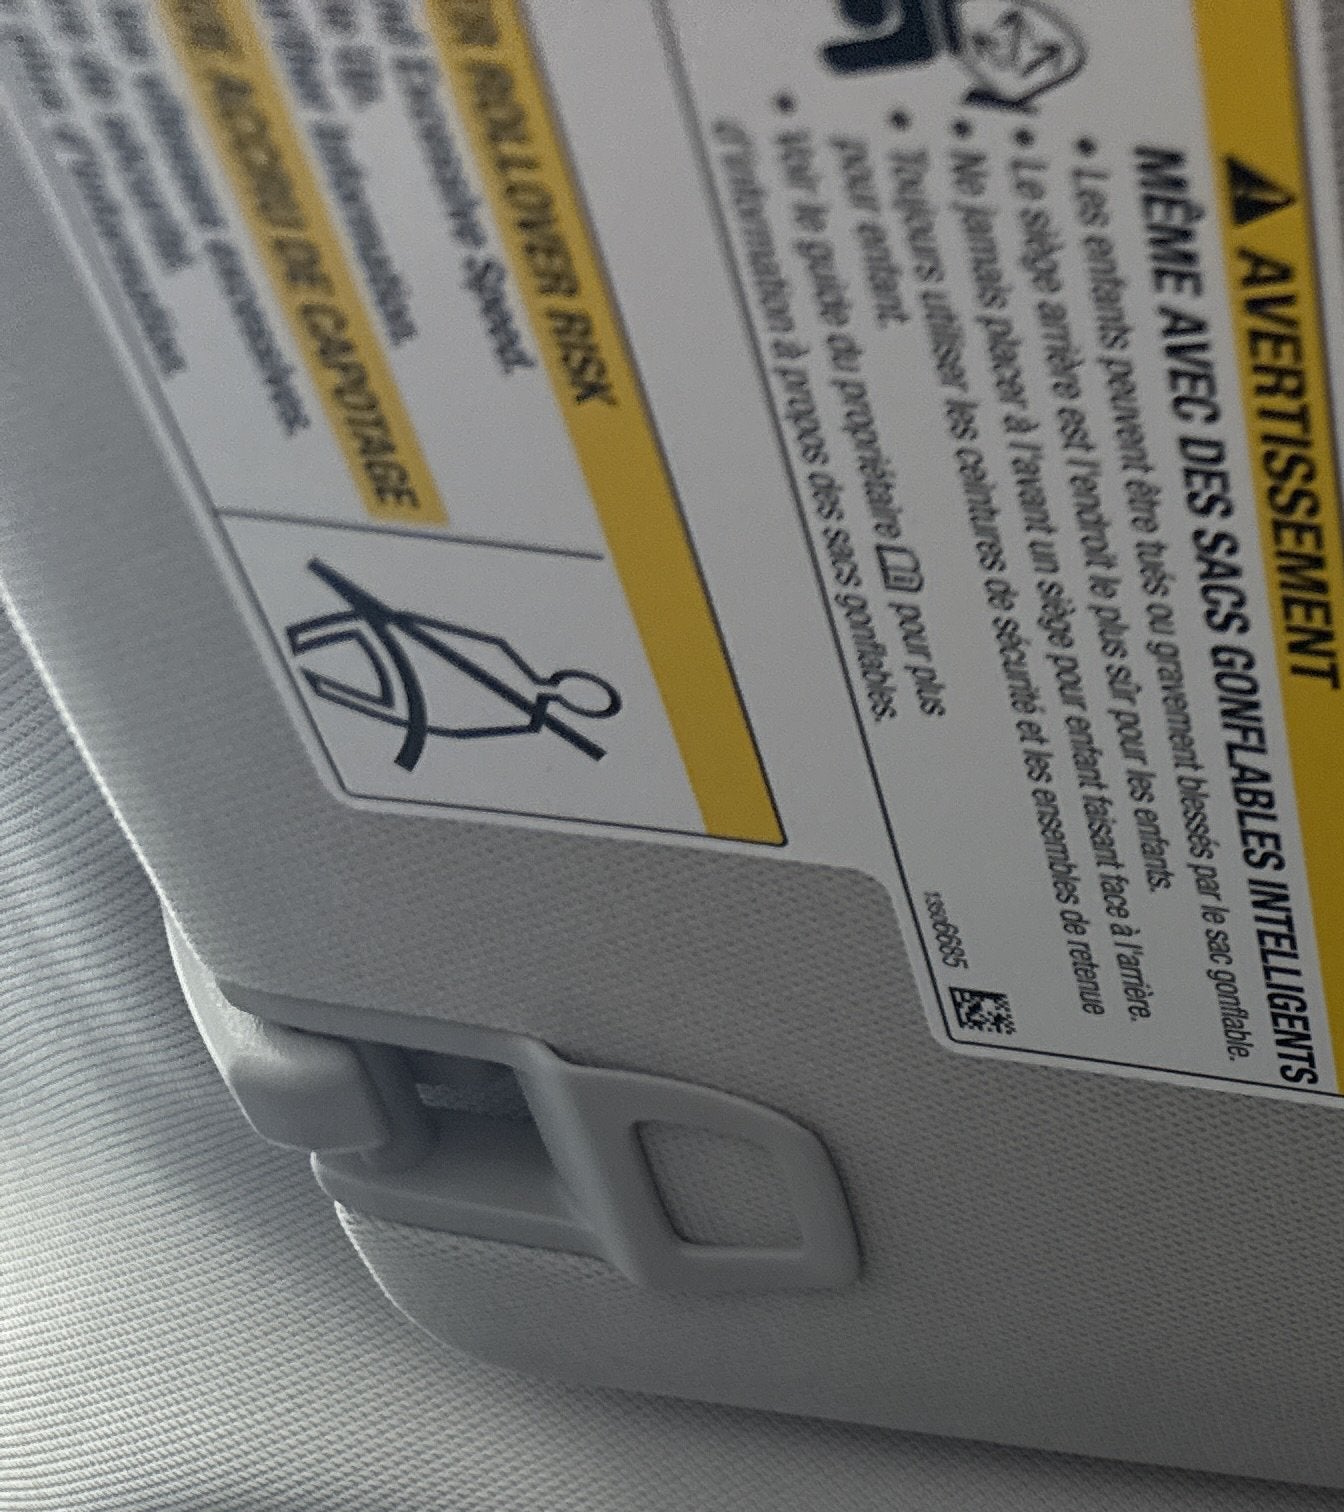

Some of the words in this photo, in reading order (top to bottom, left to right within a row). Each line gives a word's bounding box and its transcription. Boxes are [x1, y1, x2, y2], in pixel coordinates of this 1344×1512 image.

[773, 129, 821, 194] Voir
[829, 136, 881, 212] pour
[949, 150, 989, 197] Ne
[1009, 158, 1048, 202] Le
[1070, 167, 1111, 229] Les
[463, 59, 582, 299] ROLLOVER
[545, 308, 618, 407] RISK
[791, 200, 830, 233] le
[887, 147, 946, 284] Toujours
[1017, 206, 1065, 295] siège
[1132, 144, 1206, 298] MÊME
[272, 237, 333, 294] DE
[792, 238, 853, 328] guide
[854, 220, 912, 329] enfant.
[949, 201, 1013, 311] jamais
[1080, 234, 1135, 352] enfants
[770, 338, 811, 362] à
[825, 332, 864, 374] du
[920, 290, 969, 391] utiliser
[974, 315, 1029, 409] placer
[1035, 300, 1085, 402] arrière
[1157, 305, 1222, 425] AVEC
[298, 303, 421, 510] CAPOTAGE
[773, 366, 830, 466] propos
[943, 397, 980, 442] les
[1002, 413, 1041, 435] à
[1055, 406, 1096, 453] est
[1098, 358, 1155, 475] peuvent
[806, 470, 845, 523] des
[829, 377, 904, 541] propriétaire
[1007, 441, 1059, 536] l'avant
[1177, 435, 1235, 519] DES
[1236, 246, 1342, 691] AVERTISSEMENT
[953, 446, 1008, 573] ceintures
[1065, 457, 1118, 570] l'endroit
[1123, 478, 1163, 535] être
[821, 526, 863, 588] sacs
[1028, 539, 1061, 575] un
[1087, 575, 1122, 601] le
[1134, 540, 1176, 598] tués
[1191, 527, 1251, 635] SACS
[887, 601, 933, 661] pour
[983, 579, 1019, 612] de
[1035, 579, 1077, 650] siège
[1086, 604, 1131, 660] plus
[1145, 602, 1176, 635] ou
[833, 592, 898, 724] gonflables.
[903, 665, 947, 718] plus
[991, 616, 1046, 716] sécurité
[1045, 653, 1088, 711] pour
[1104, 663, 1143, 707] sûr
[1014, 718, 1050, 746] et
[1106, 709, 1149, 766] pour
[1144, 639, 1204, 771] gravement
[1022, 748, 1054, 784] les
[1064, 715, 1110, 792] enfant
[1125, 768, 1157, 804] les
[1209, 644, 1286, 872] GONFLABLES
[1031, 787, 1082, 906] ensembles
[1081, 794, 1126, 870] faisant
[1132, 807, 1176, 894] enfants.
[1175, 775, 1220, 860] blessés
[1098, 872, 1131, 920] face
[1186, 863, 1223, 900] par
[1200, 904, 1230, 925] le
[1058, 908, 1091, 937] de
[1109, 922, 1141, 938] à
[1204, 928, 1234, 965] sac
[1066, 939, 1106, 1016] retenue
[1113, 941, 1155, 1023] l'arrière.
[1205, 968, 1254, 1062] gonflable.
[1247, 877, 1319, 1085] INTELLIGENTS
